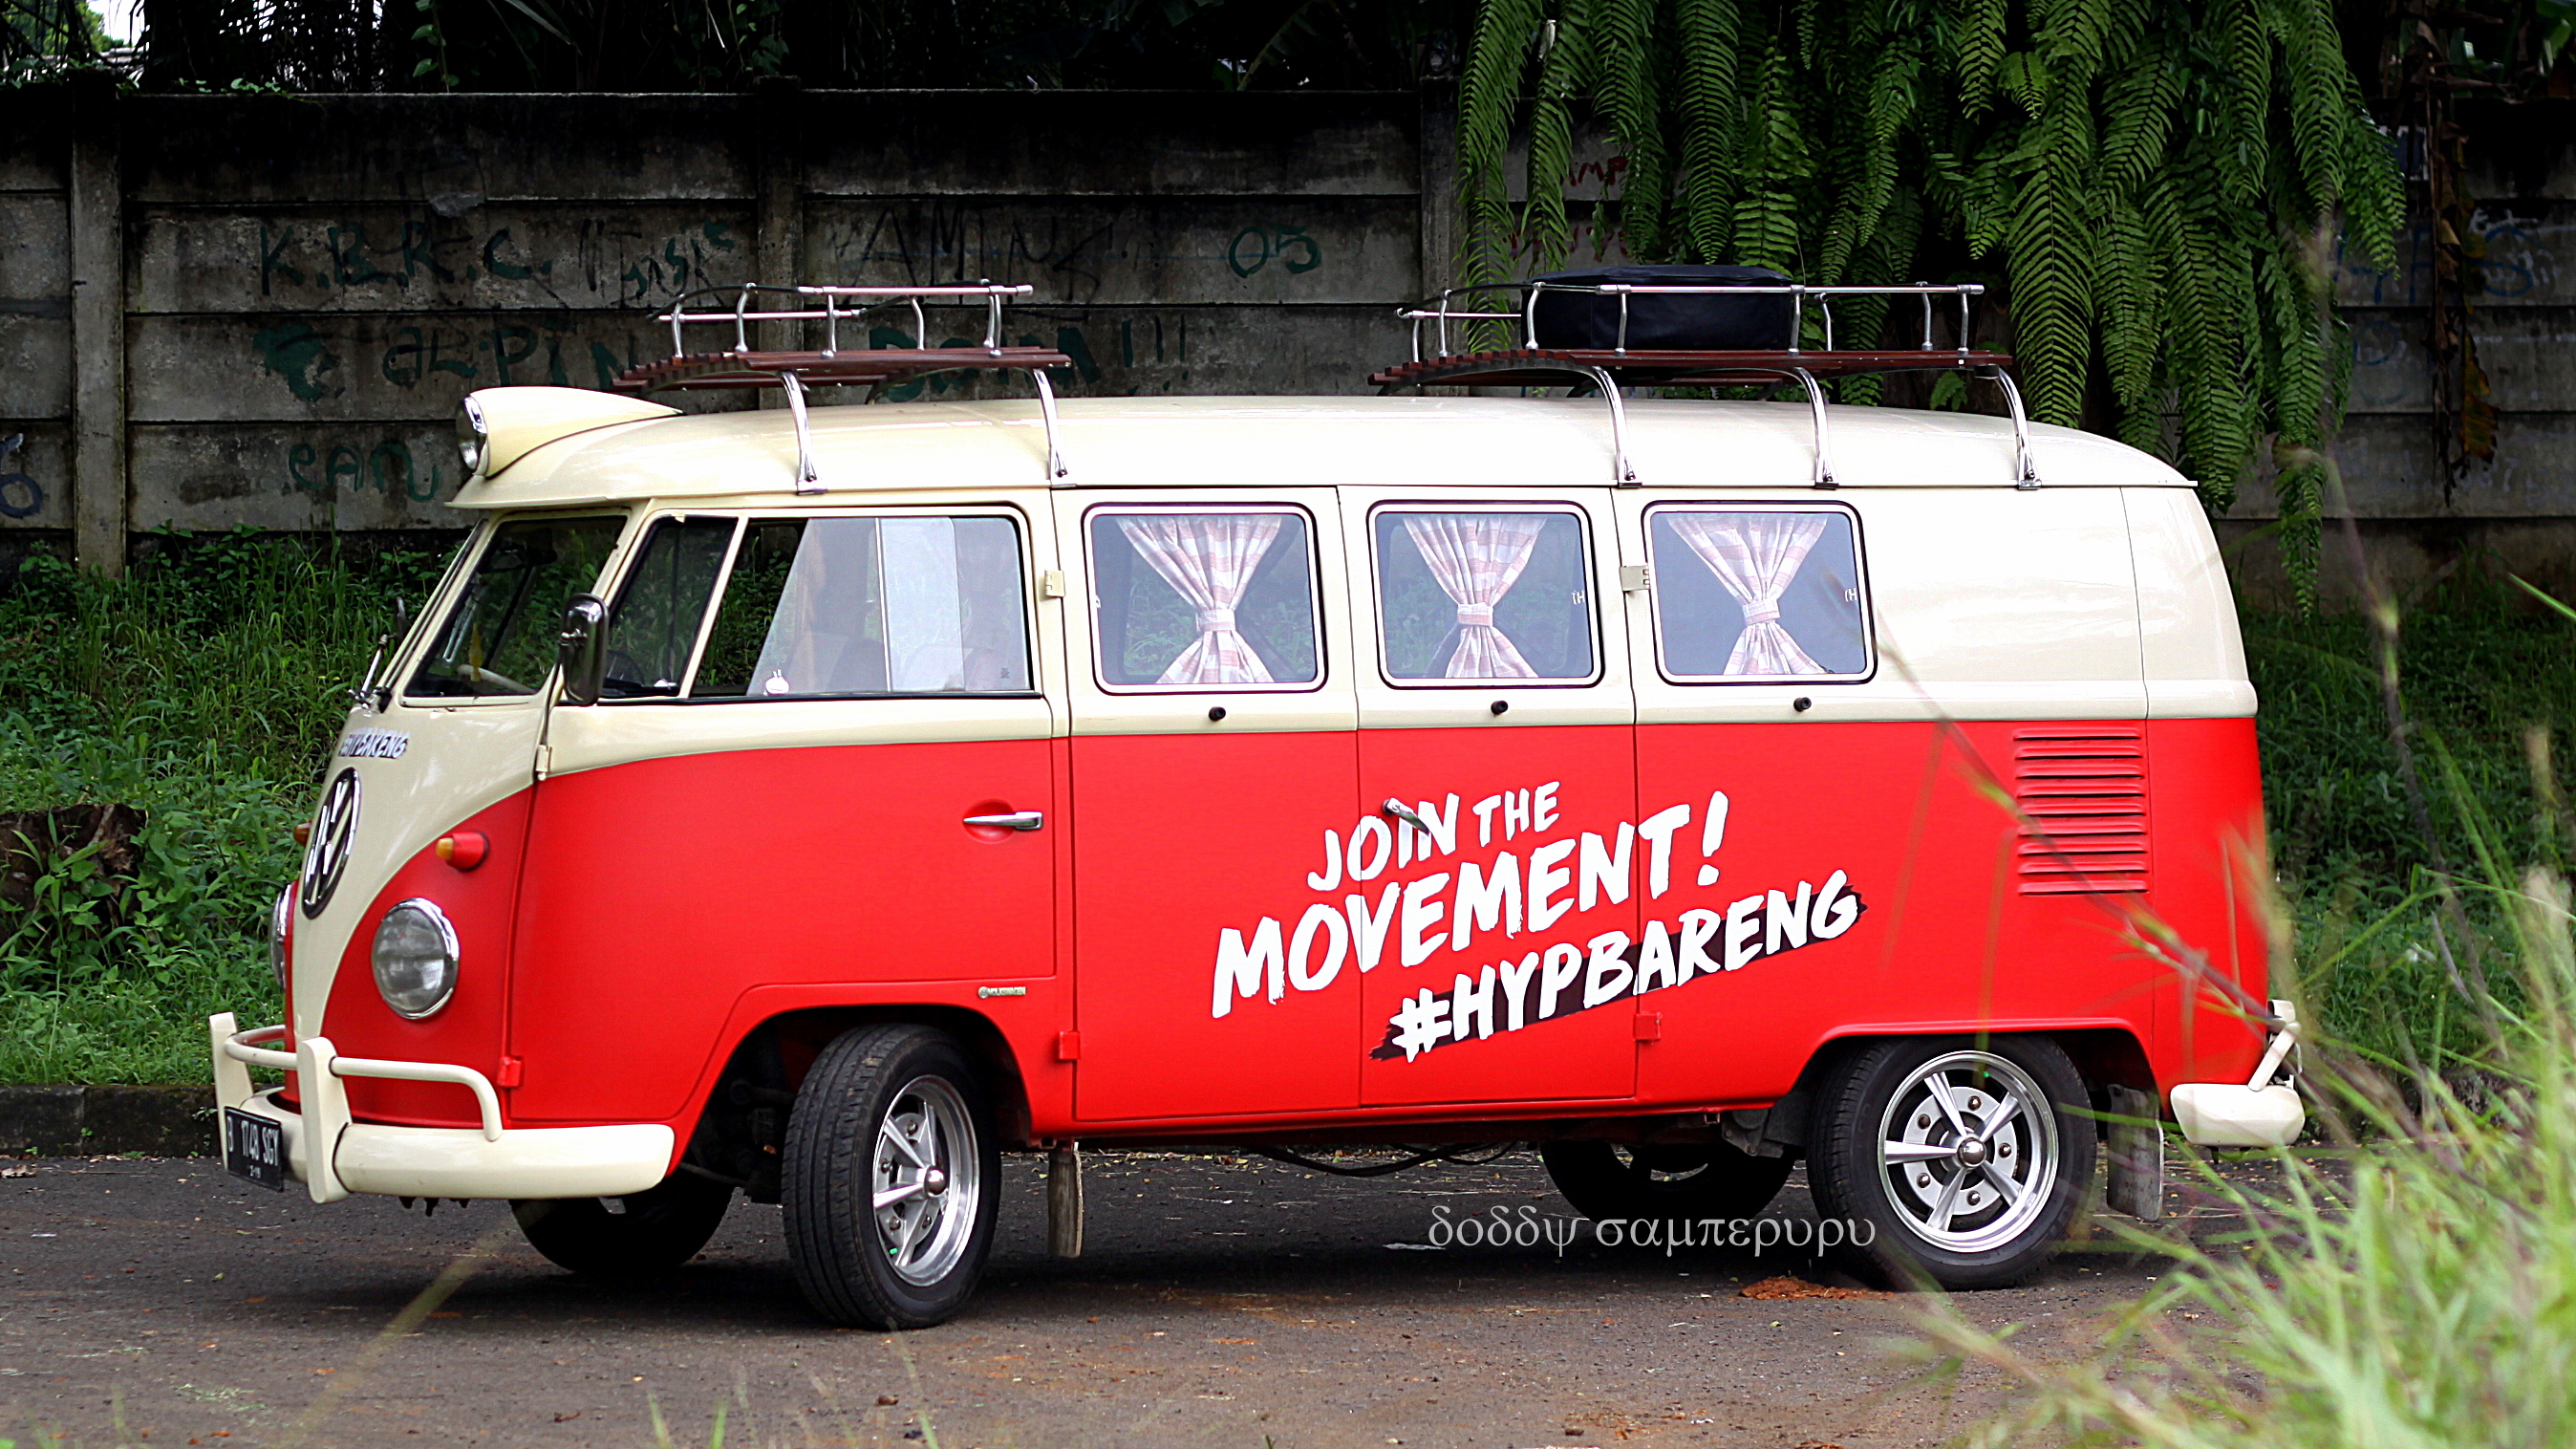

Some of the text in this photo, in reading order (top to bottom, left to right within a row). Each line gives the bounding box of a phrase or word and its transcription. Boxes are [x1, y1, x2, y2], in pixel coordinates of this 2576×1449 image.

[1229, 225, 1321, 278] 05
[1212, 790, 1728, 1019] MOVEMENT!
[1307, 781, 1560, 892] JOIN THE
[1389, 869, 1861, 1063] #HYPBARENG
